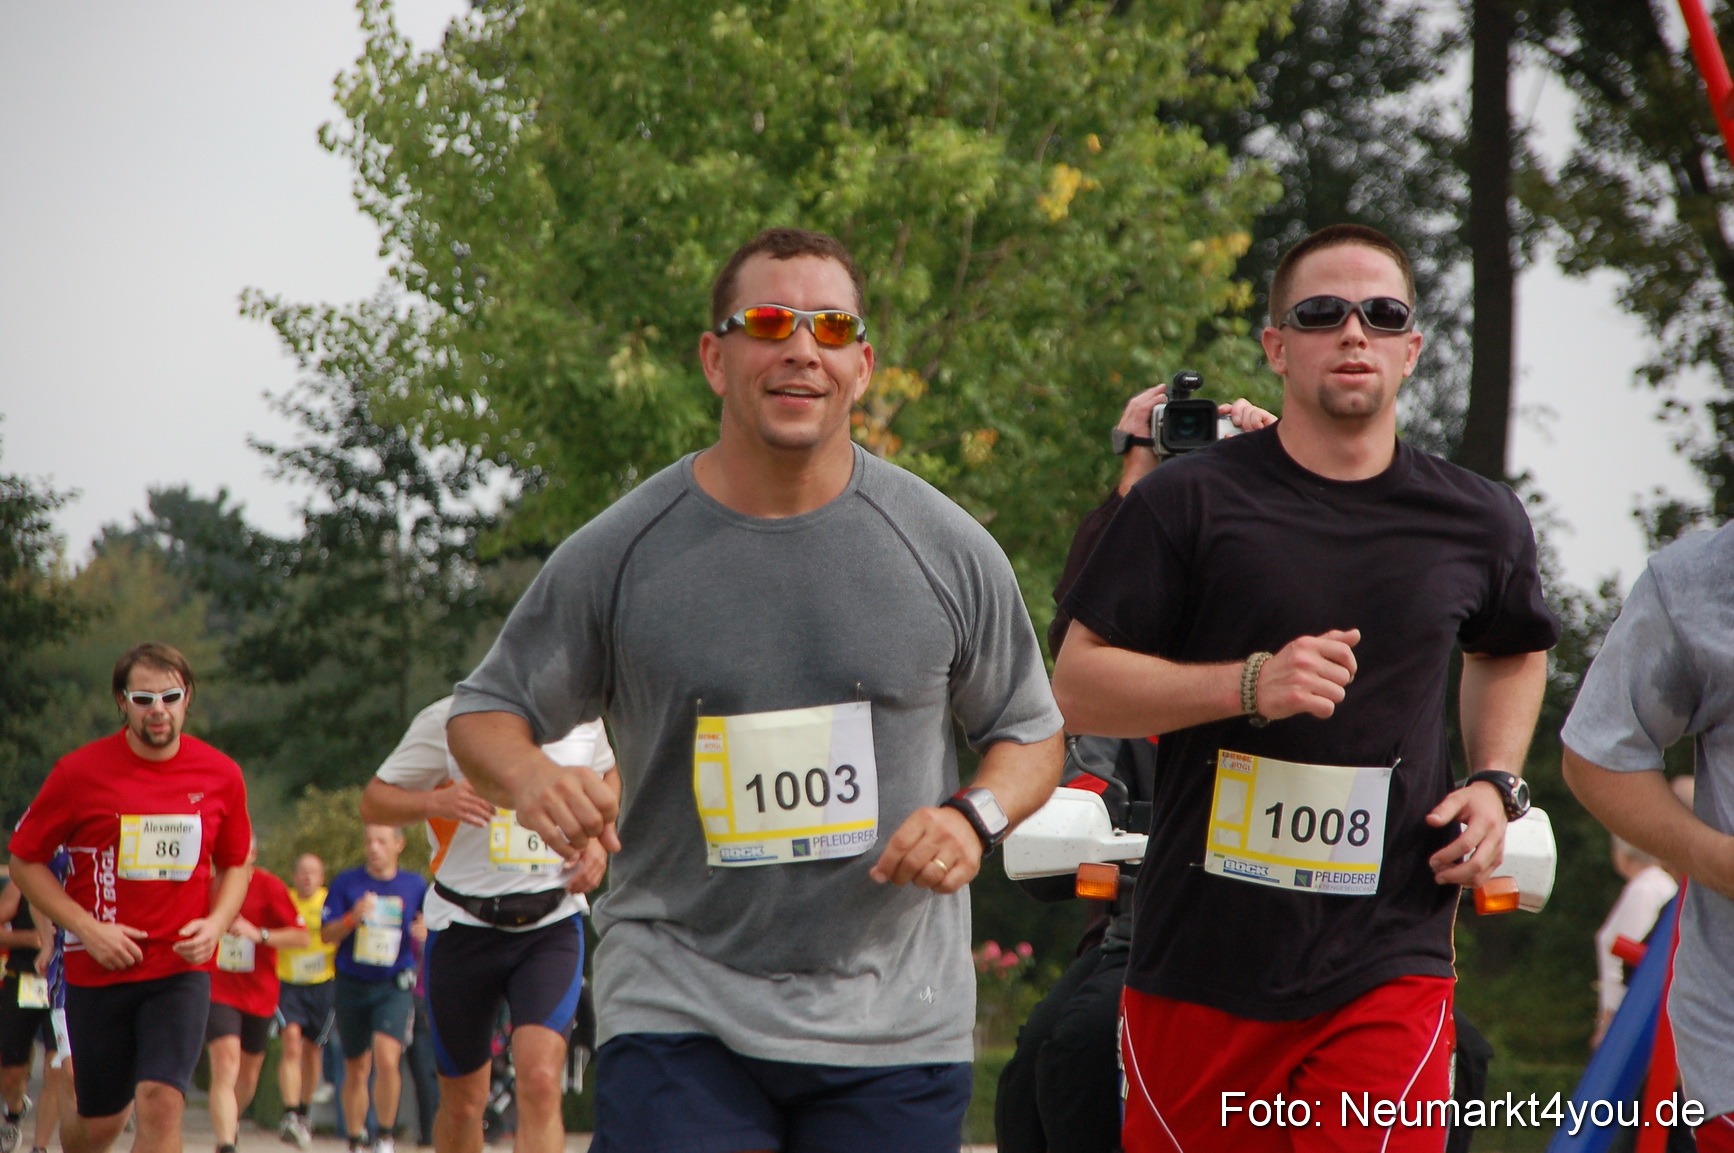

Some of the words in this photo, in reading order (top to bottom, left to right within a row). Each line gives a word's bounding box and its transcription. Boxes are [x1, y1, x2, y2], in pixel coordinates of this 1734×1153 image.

[745, 763, 862, 813] 1003
[143, 821, 194, 834] Alexander
[1265, 801, 1371, 847] 1008
[812, 829, 876, 848] PFLEIDERER
[155, 841, 180, 858] 86
[720, 845, 765, 859] BOCK
[99, 845, 117, 903] BÖGL
[1224, 859, 1269, 876] BOCK
[1315, 871, 1377, 885] PFLEIDERER
